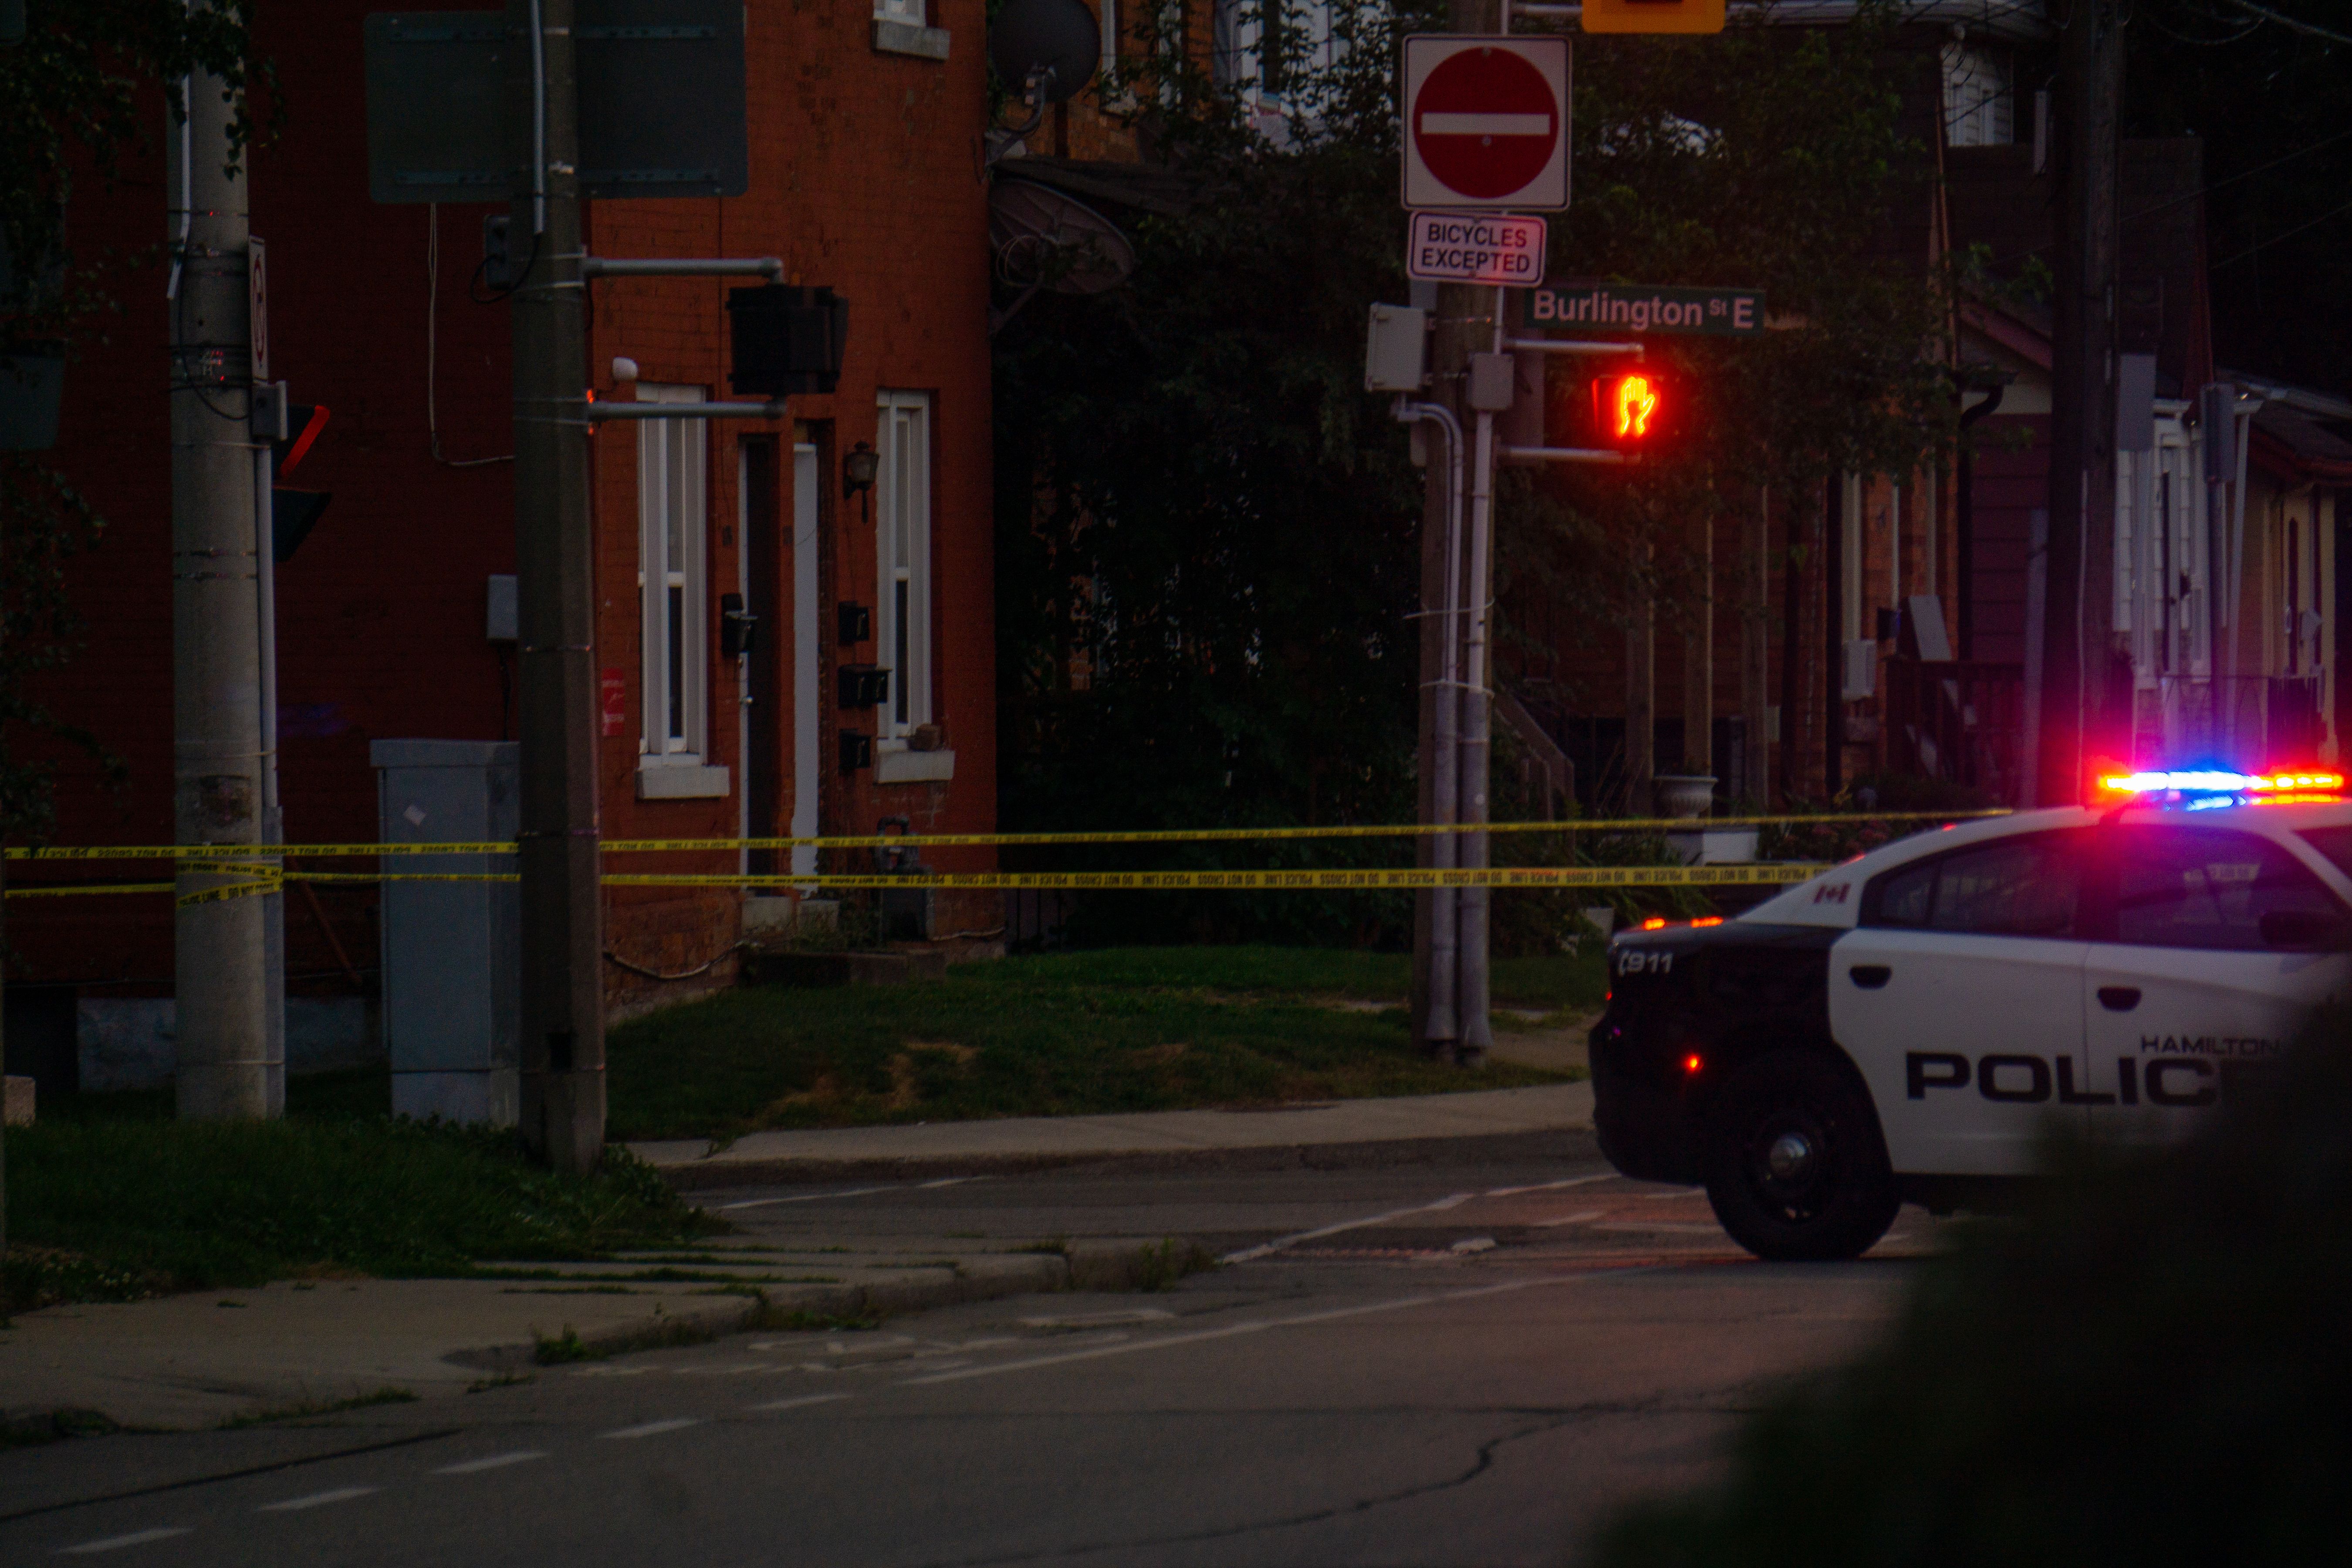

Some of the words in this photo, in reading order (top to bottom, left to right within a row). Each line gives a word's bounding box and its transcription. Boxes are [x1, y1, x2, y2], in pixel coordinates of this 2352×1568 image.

[1428, 223, 1527, 247] BICYCLES
[1422, 247, 1530, 273] EXCEPTED
[1533, 289, 1703, 331] Burlington
[1709, 298, 1728, 317] St
[1733, 296, 1755, 329] E
[2141, 1034, 2281, 1056] HAMILTON
